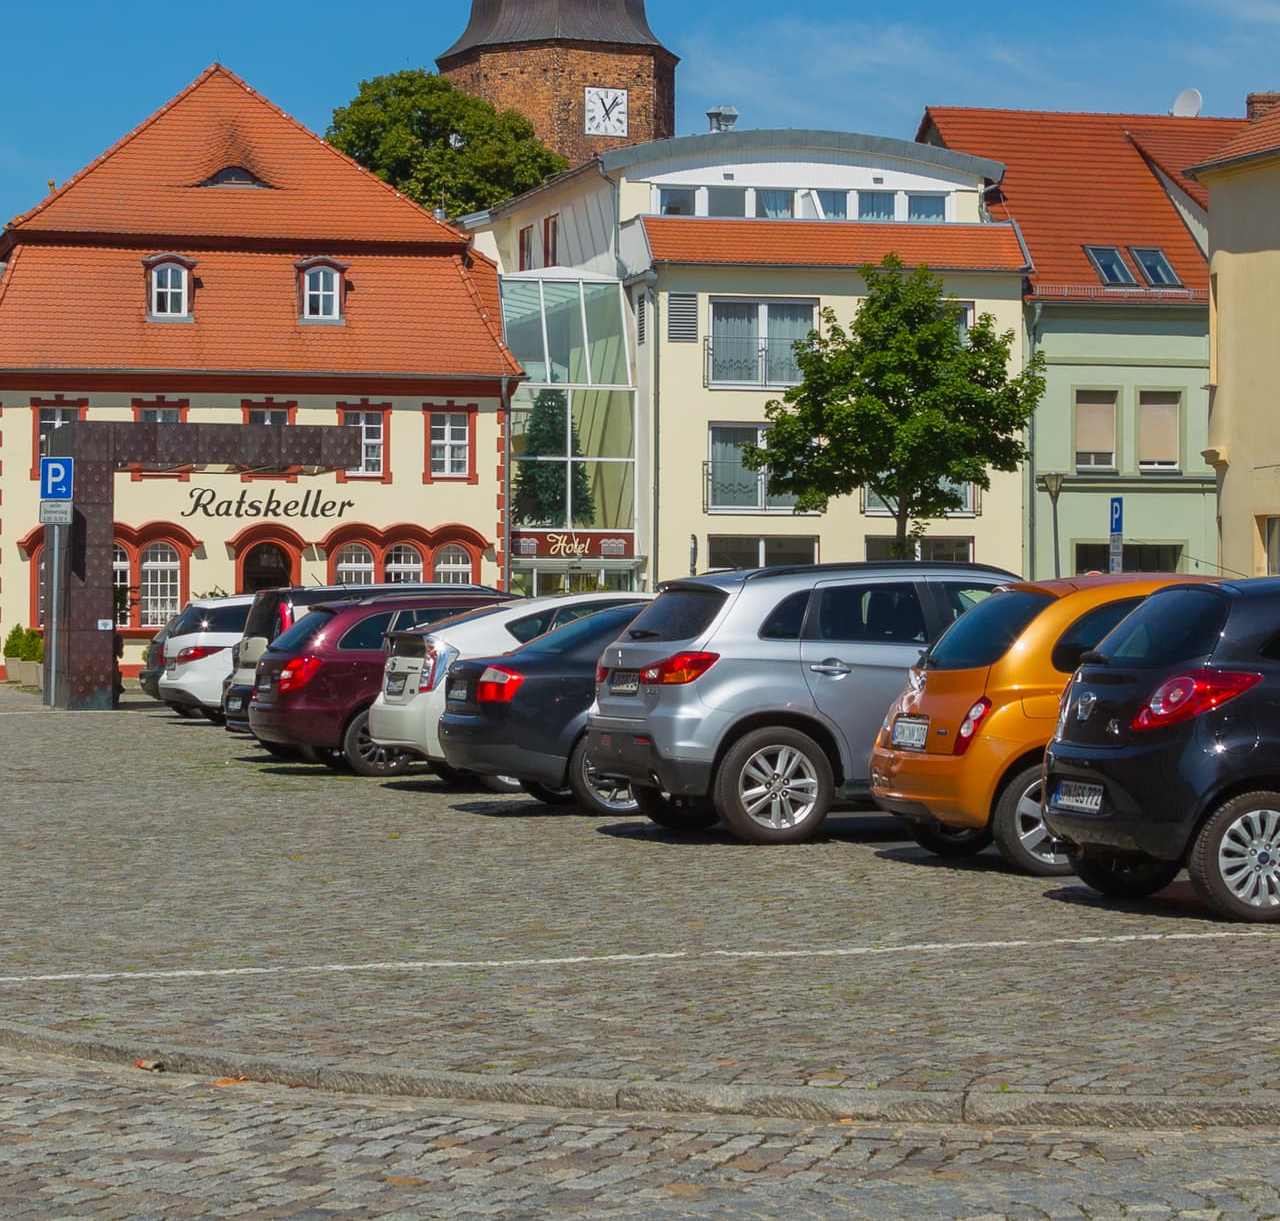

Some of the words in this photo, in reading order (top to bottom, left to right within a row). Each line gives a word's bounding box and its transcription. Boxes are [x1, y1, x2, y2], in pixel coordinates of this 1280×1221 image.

[47, 462, 65, 494] P
[180, 487, 355, 518] Ratskeller
[1112, 502, 1121, 530] P
[546, 533, 591, 557] Hotel
[1085, 787, 1102, 807] 772
